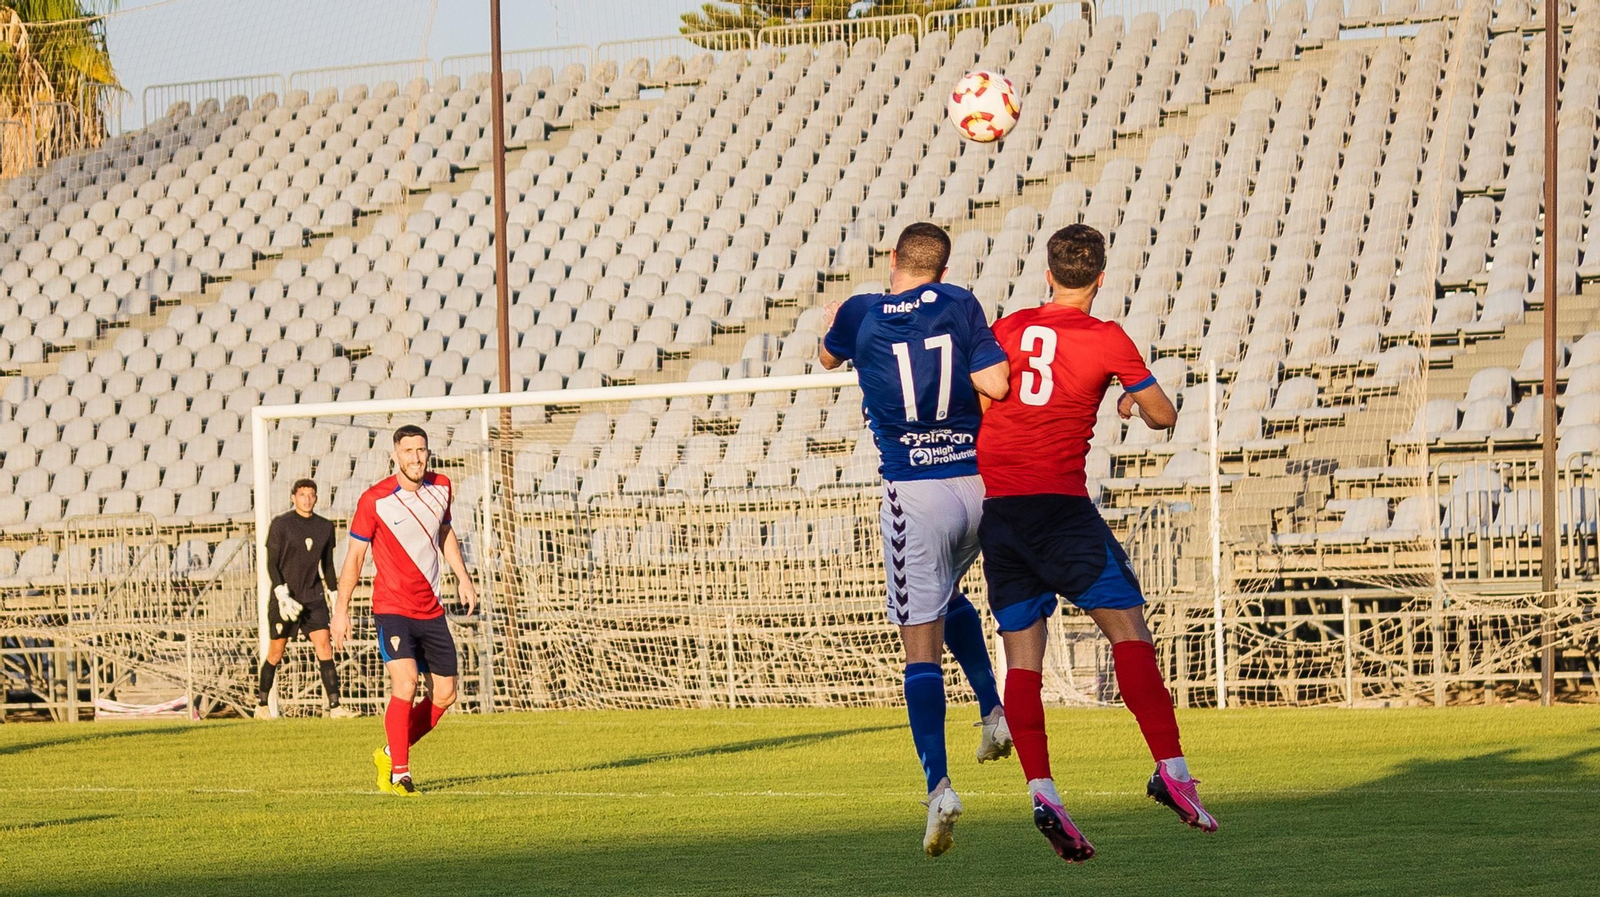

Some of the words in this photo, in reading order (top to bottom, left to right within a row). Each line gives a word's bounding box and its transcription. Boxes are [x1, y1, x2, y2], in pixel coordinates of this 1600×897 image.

[892, 333, 952, 422] 17
[1019, 325, 1057, 406] 3
[931, 445, 954, 457] High
